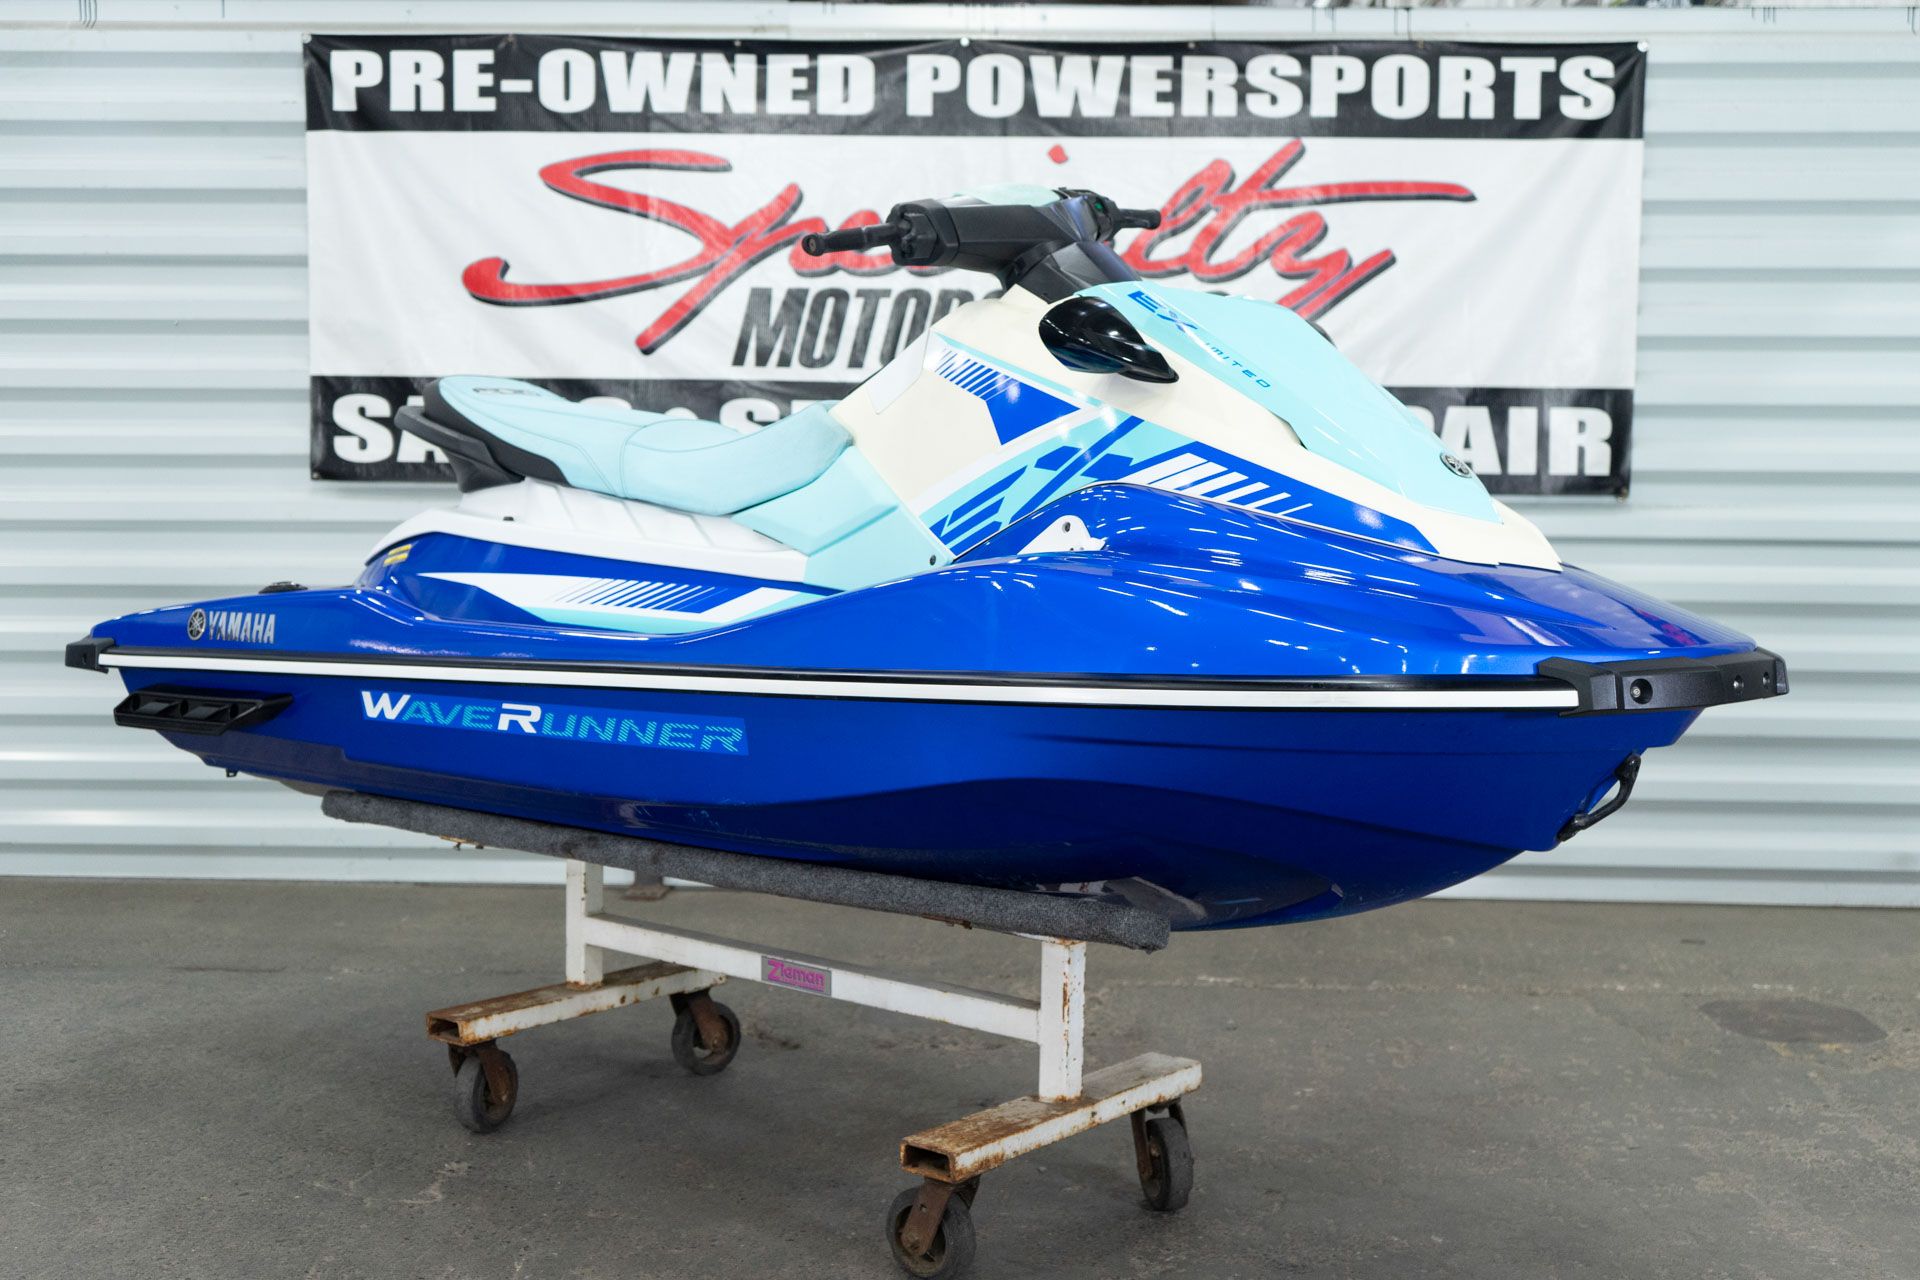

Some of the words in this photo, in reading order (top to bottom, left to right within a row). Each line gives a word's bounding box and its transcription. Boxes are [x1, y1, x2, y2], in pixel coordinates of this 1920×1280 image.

[330, 48, 876, 116] PRE-OWNED
[906, 52, 1617, 121] POWERSPORTS
[208, 610, 276, 644] YAMAHA
